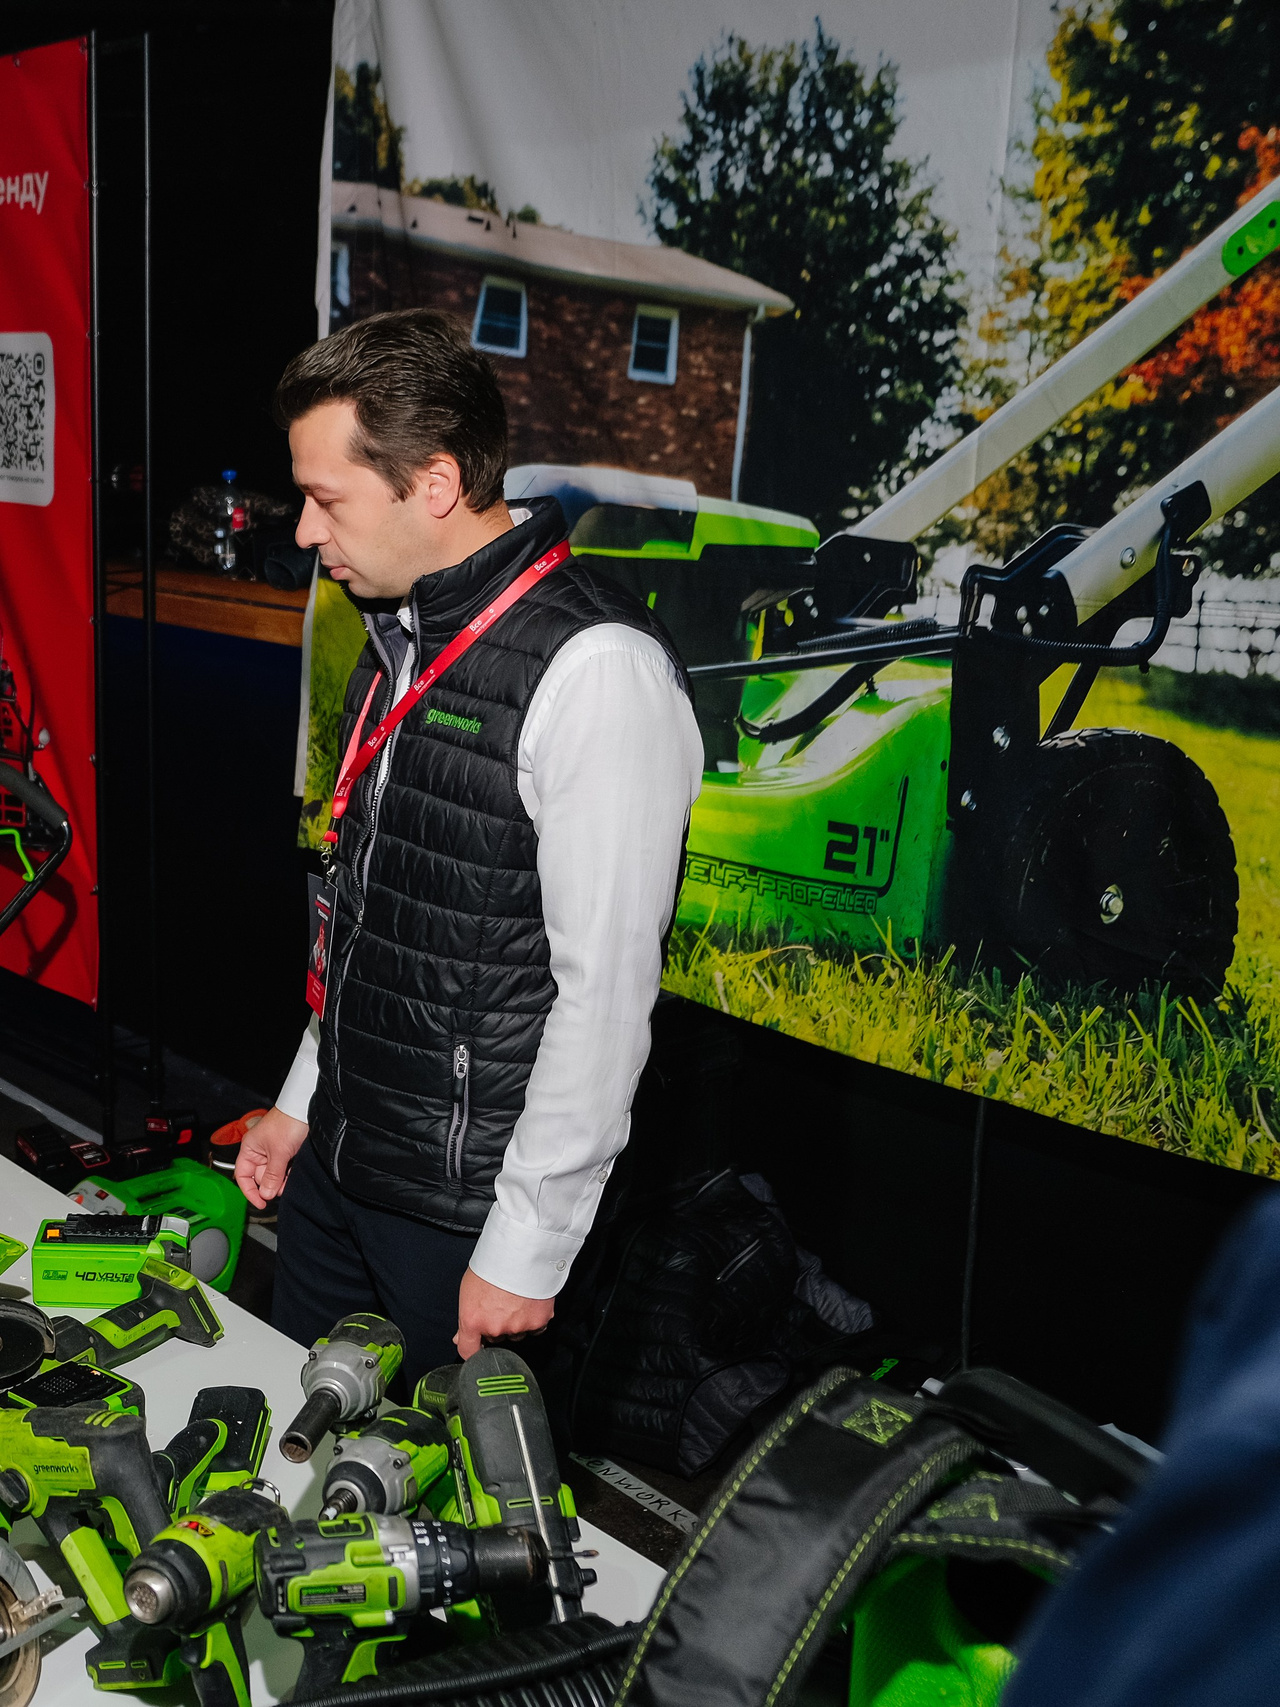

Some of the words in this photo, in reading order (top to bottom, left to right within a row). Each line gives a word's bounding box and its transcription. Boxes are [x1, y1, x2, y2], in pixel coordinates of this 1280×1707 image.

[425, 708, 482, 734] greenworks
[823, 820, 890, 877] 21"
[686, 857, 878, 915] ELF-PROPELLED
[75, 1271, 97, 1281] 40
[33, 1463, 79, 1475] greenworks
